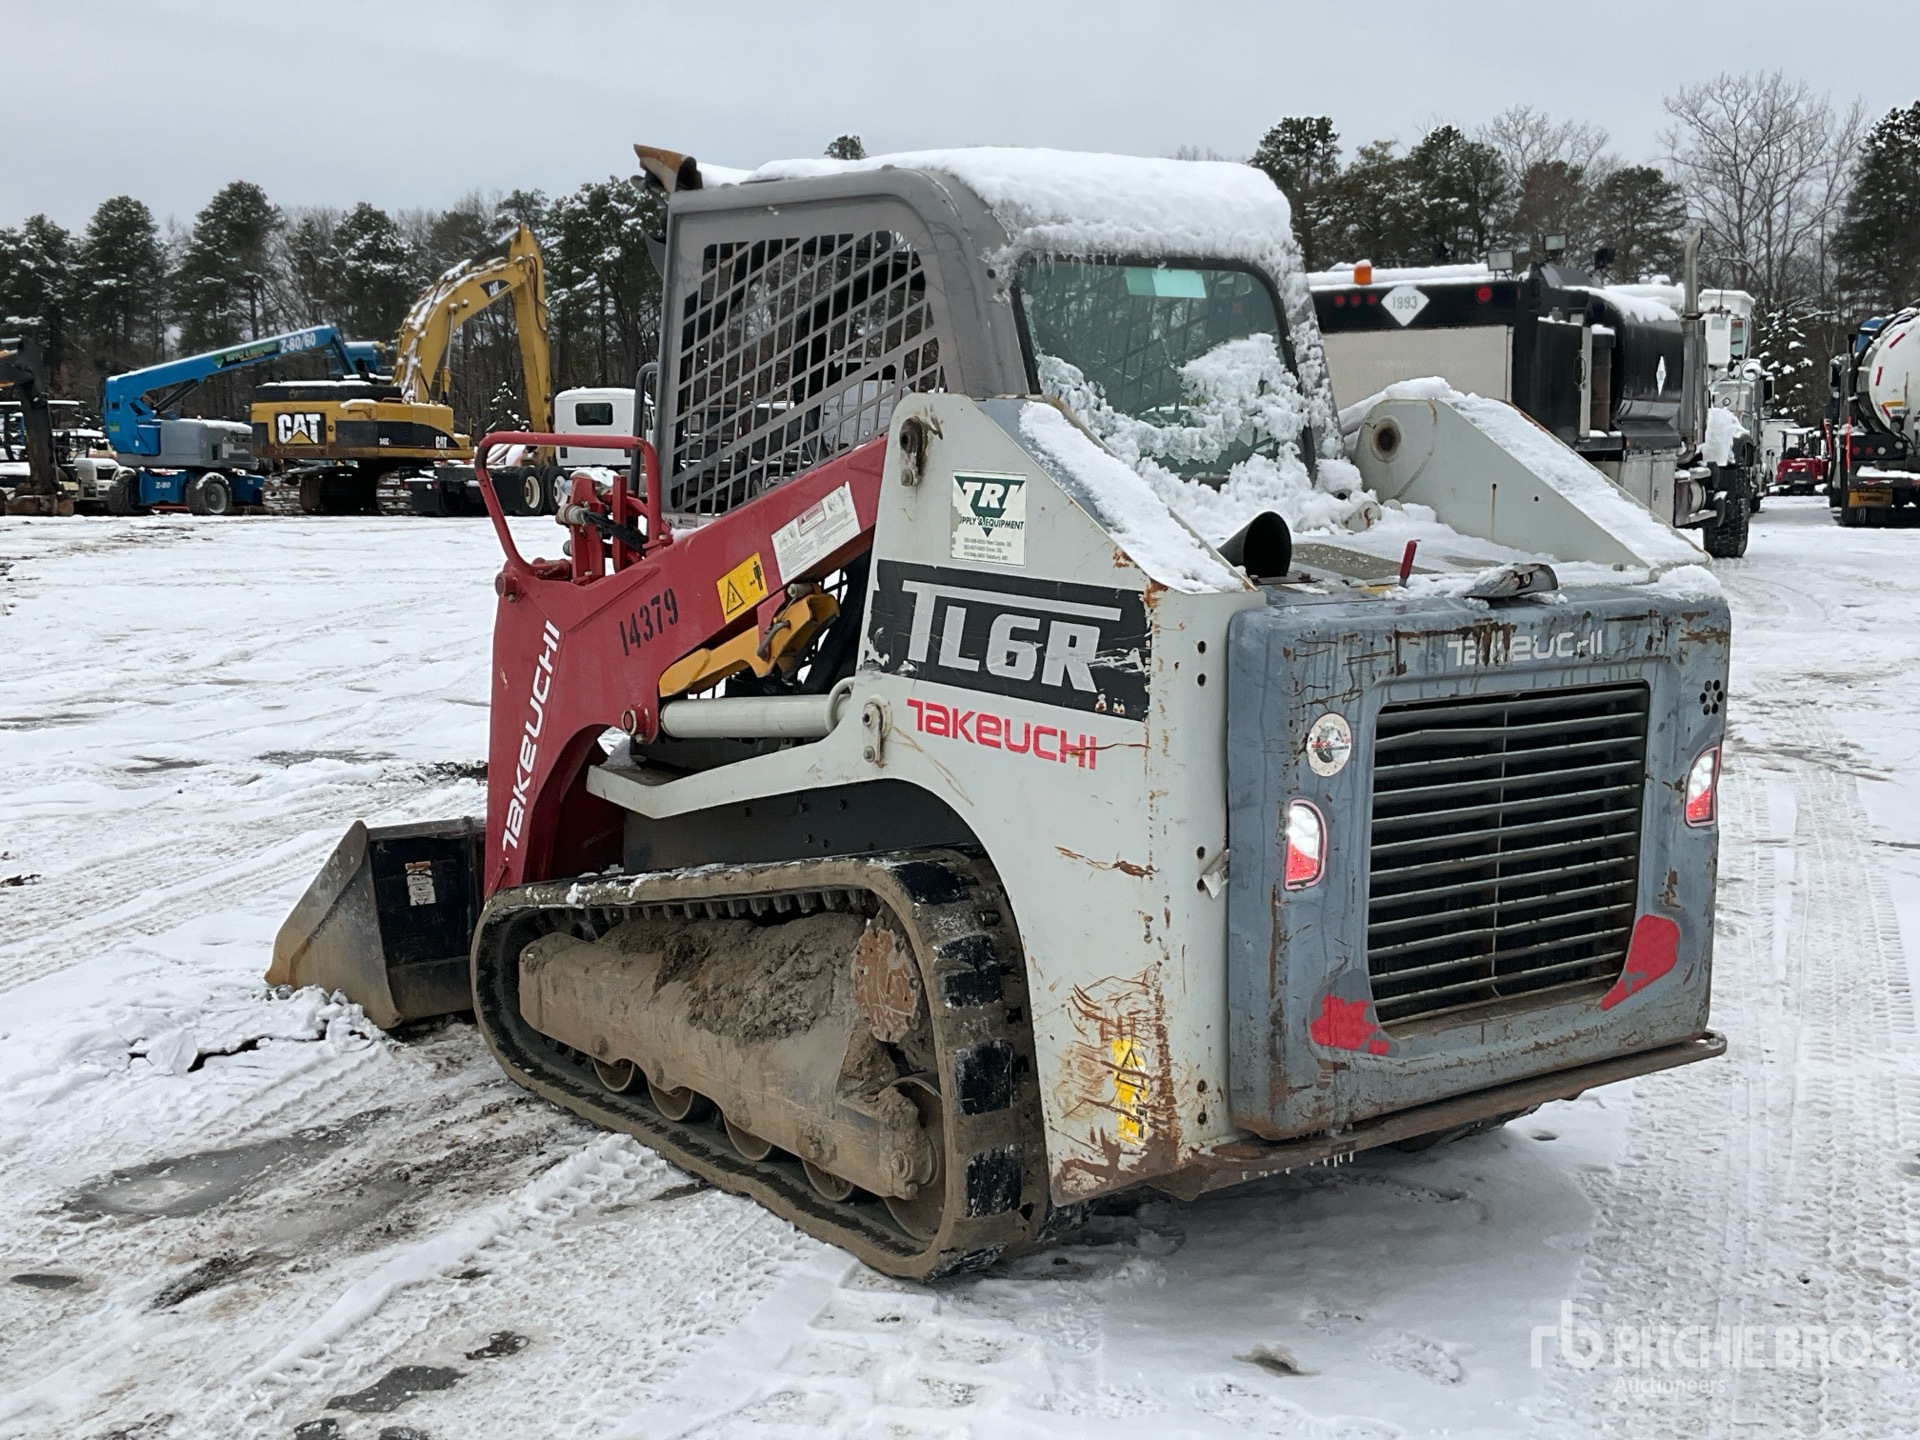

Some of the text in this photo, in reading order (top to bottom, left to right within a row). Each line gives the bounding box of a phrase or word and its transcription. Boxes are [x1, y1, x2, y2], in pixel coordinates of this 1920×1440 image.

[1392, 296, 1417, 310] 1993
[280, 332, 316, 354] Z-80/60
[277, 413, 321, 444] CAT
[435, 436, 448, 449] CAT
[155, 481, 171, 489] Z-80
[962, 481, 1020, 509] TRI
[984, 517, 1025, 530] EQUIPMENT
[619, 587, 679, 657] 14379
[901, 580, 1122, 694] TL6R
[502, 619, 560, 852] TAKEUCHI
[907, 698, 1097, 771] TAKEUCHI
